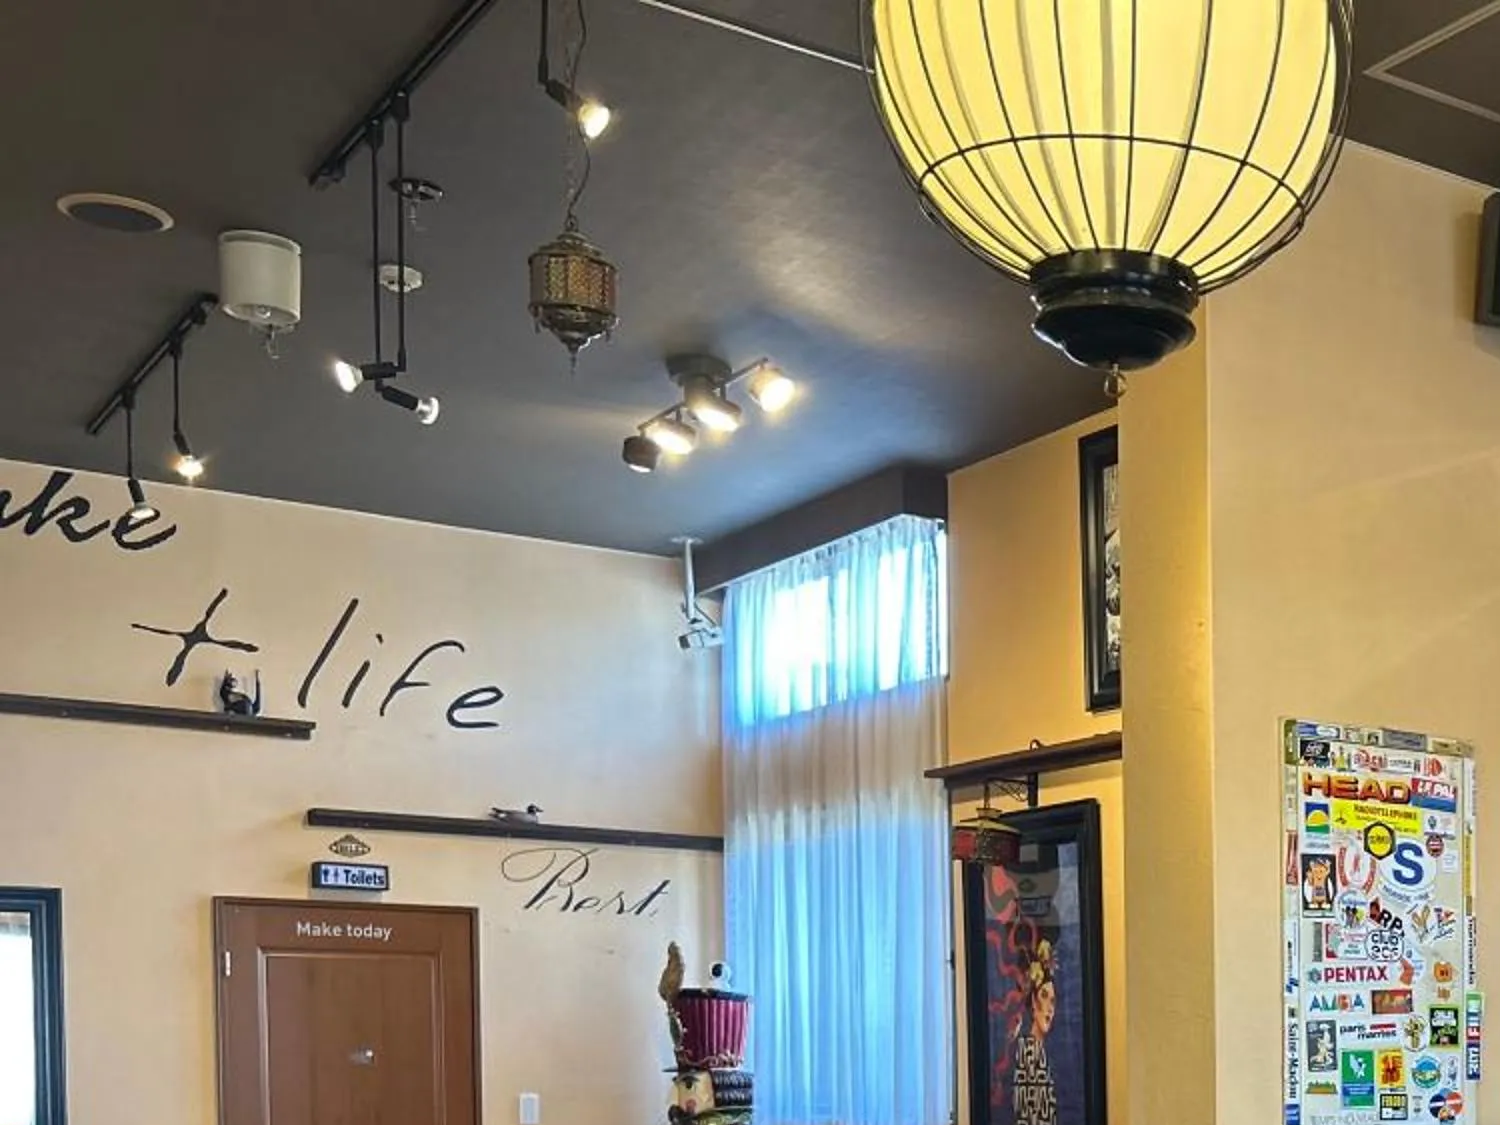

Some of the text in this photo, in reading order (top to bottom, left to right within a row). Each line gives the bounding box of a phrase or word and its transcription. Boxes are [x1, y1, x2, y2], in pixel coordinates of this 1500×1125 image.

[297, 597, 505, 729] life
[1302, 771, 1412, 805] HEAD
[343, 868, 386, 886] Toilets
[1392, 841, 1425, 887] S
[501, 847, 671, 916] Rest
[296, 921, 393, 942] Make today
[1323, 965, 1389, 984] PENTAX
